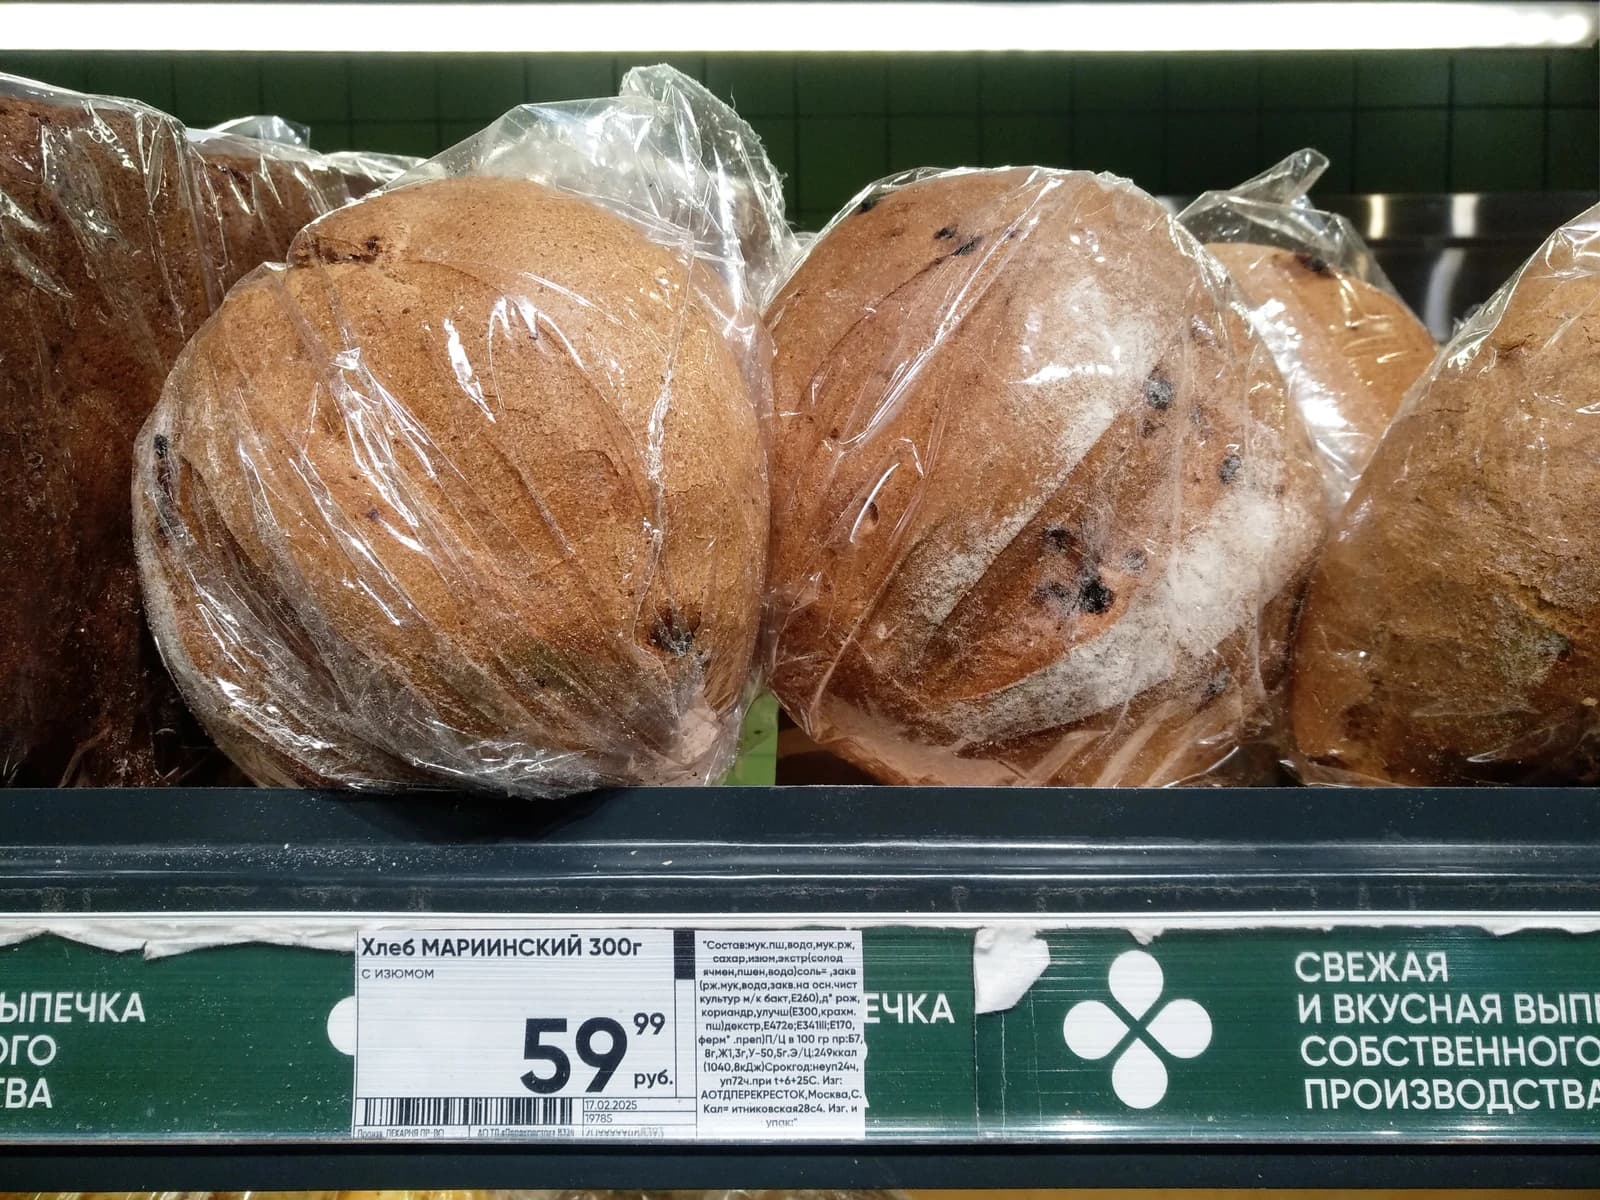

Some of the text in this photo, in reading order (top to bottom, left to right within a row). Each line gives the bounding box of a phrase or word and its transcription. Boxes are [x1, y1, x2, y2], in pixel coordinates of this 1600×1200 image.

[361, 933, 643, 957] Хлеб МАРИИНСКИЙ 300г
[1294, 951, 1449, 983] СВЕЖАЯ
[699, 994, 741, 1005] культур
[743, 993, 761, 1004] м/к
[1297, 993, 1322, 1024] И
[1333, 993, 1503, 1024] ВКУСНАЯ
[788, 1036, 795, 1044] в
[797, 1034, 815, 1044] 100
[817, 1036, 829, 1046] гр
[520, 1012, 666, 1095] 59 99
[1300, 1035, 1600, 1067] СОБСТВЕННОГО
[633, 1069, 674, 1088] руб.
[584, 1099, 638, 1110] 17.02.2025
[851, 1105, 858, 1113] и
[584, 1113, 613, 1124] 19785
